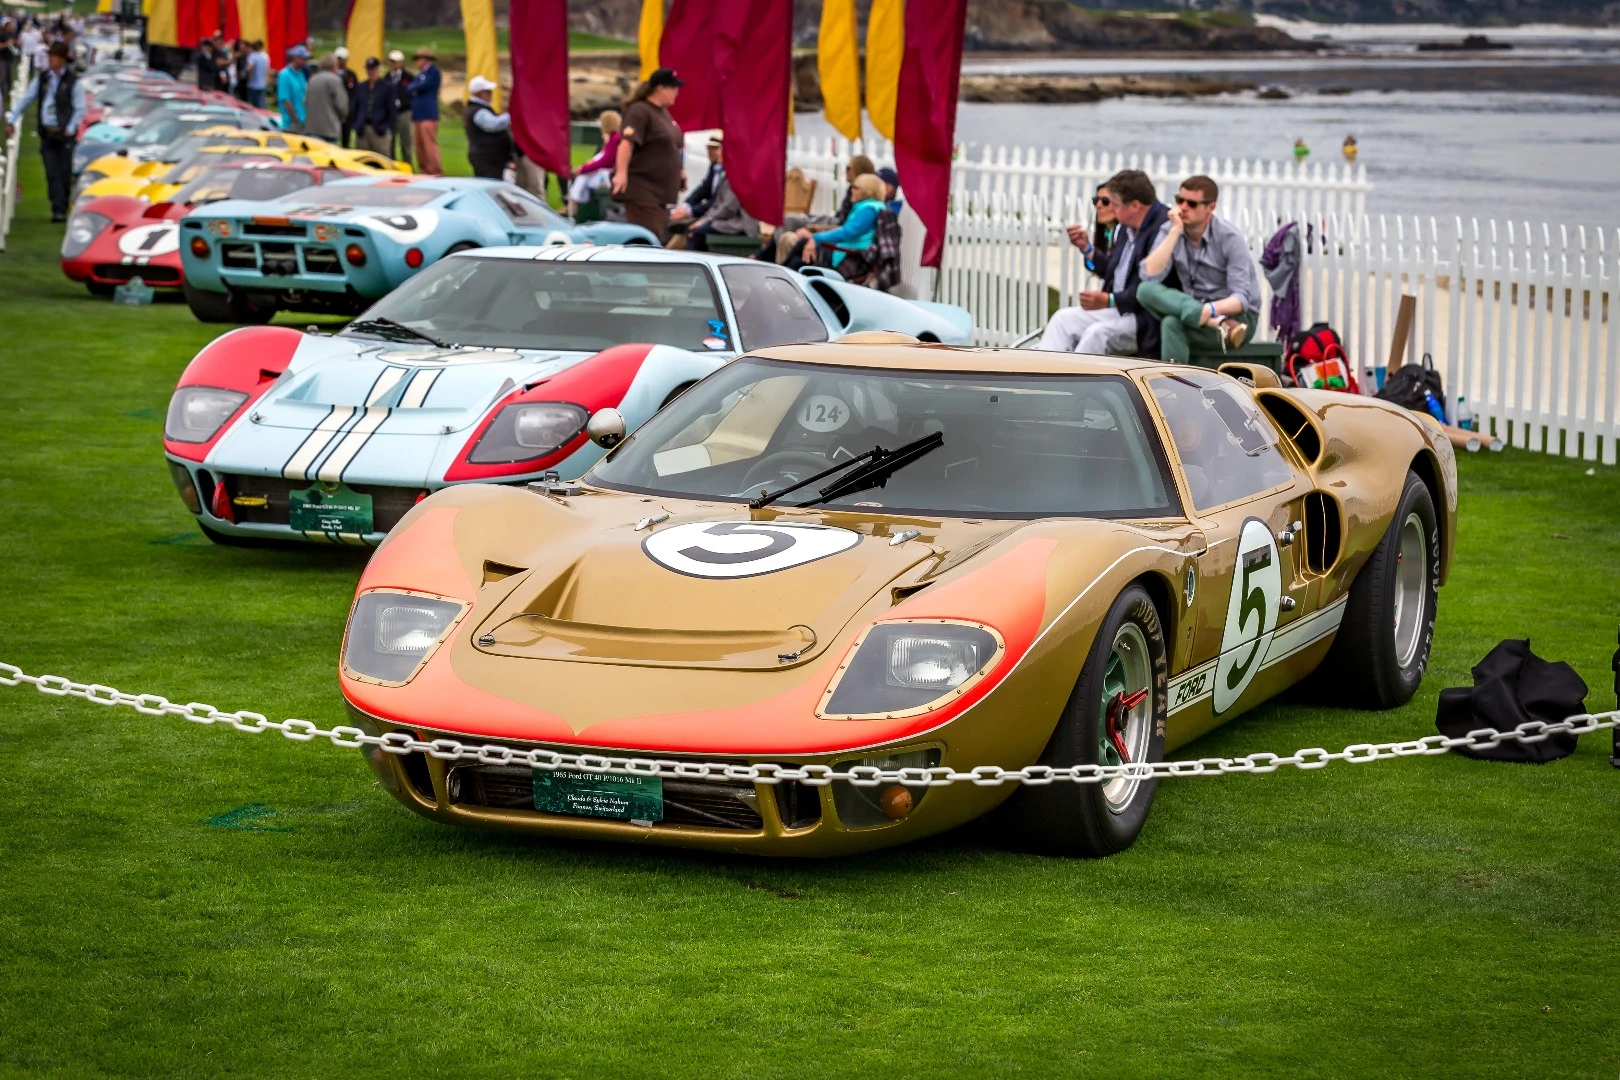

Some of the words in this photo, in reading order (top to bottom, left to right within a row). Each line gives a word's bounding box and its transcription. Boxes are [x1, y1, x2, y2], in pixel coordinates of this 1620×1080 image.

[139, 229, 173, 251] 1
[805, 404, 839, 423] 124
[677, 522, 825, 565] 5
[1226, 543, 1272, 691] 5
[1174, 672, 1208, 706] FORD
[568, 772, 582, 780] Ford
